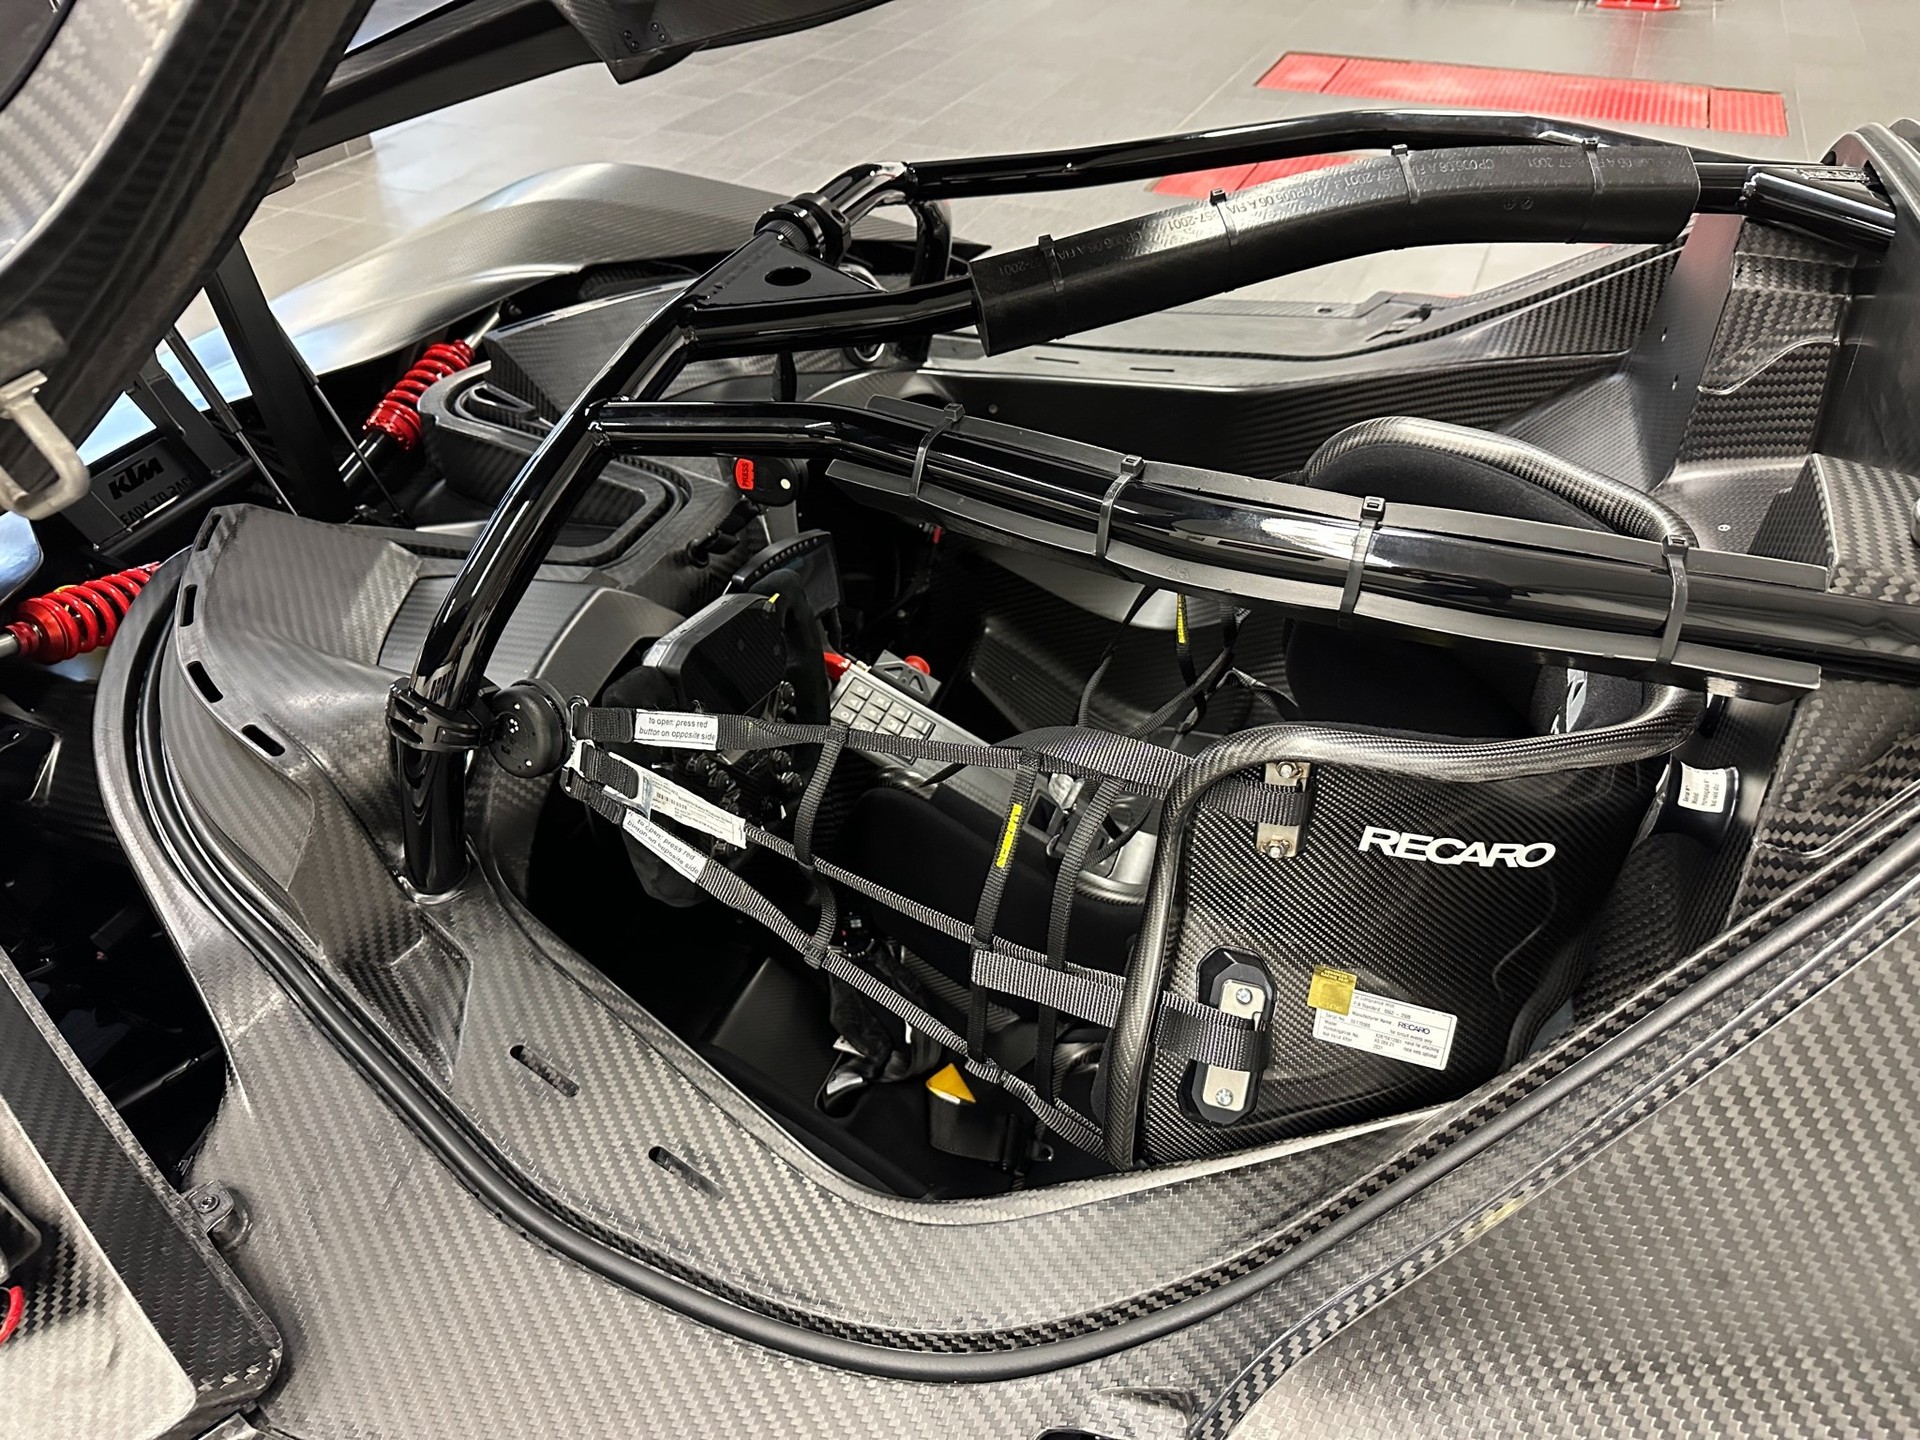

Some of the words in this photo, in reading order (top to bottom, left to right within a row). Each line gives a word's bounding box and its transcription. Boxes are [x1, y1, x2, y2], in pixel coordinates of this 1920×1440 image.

[107, 456, 165, 500] KTM
[741, 462, 749, 488] PRESS
[120, 500, 151, 526] EADY
[638, 727, 660, 737] button
[660, 729, 670, 737] on
[671, 729, 700, 740] opposite
[701, 732, 716, 742] side
[648, 717, 656, 725] to
[675, 719, 696, 729] press
[696, 719, 708, 729] red
[627, 820, 649, 837] button
[647, 835, 657, 844] on
[656, 842, 685, 864] opposite
[684, 861, 700, 874] side
[637, 818, 646, 826] to
[663, 837, 683, 853] press
[682, 849, 696, 861] red
[1358, 825, 1556, 868] RECARO
[1397, 1021, 1431, 1035] RECARO
